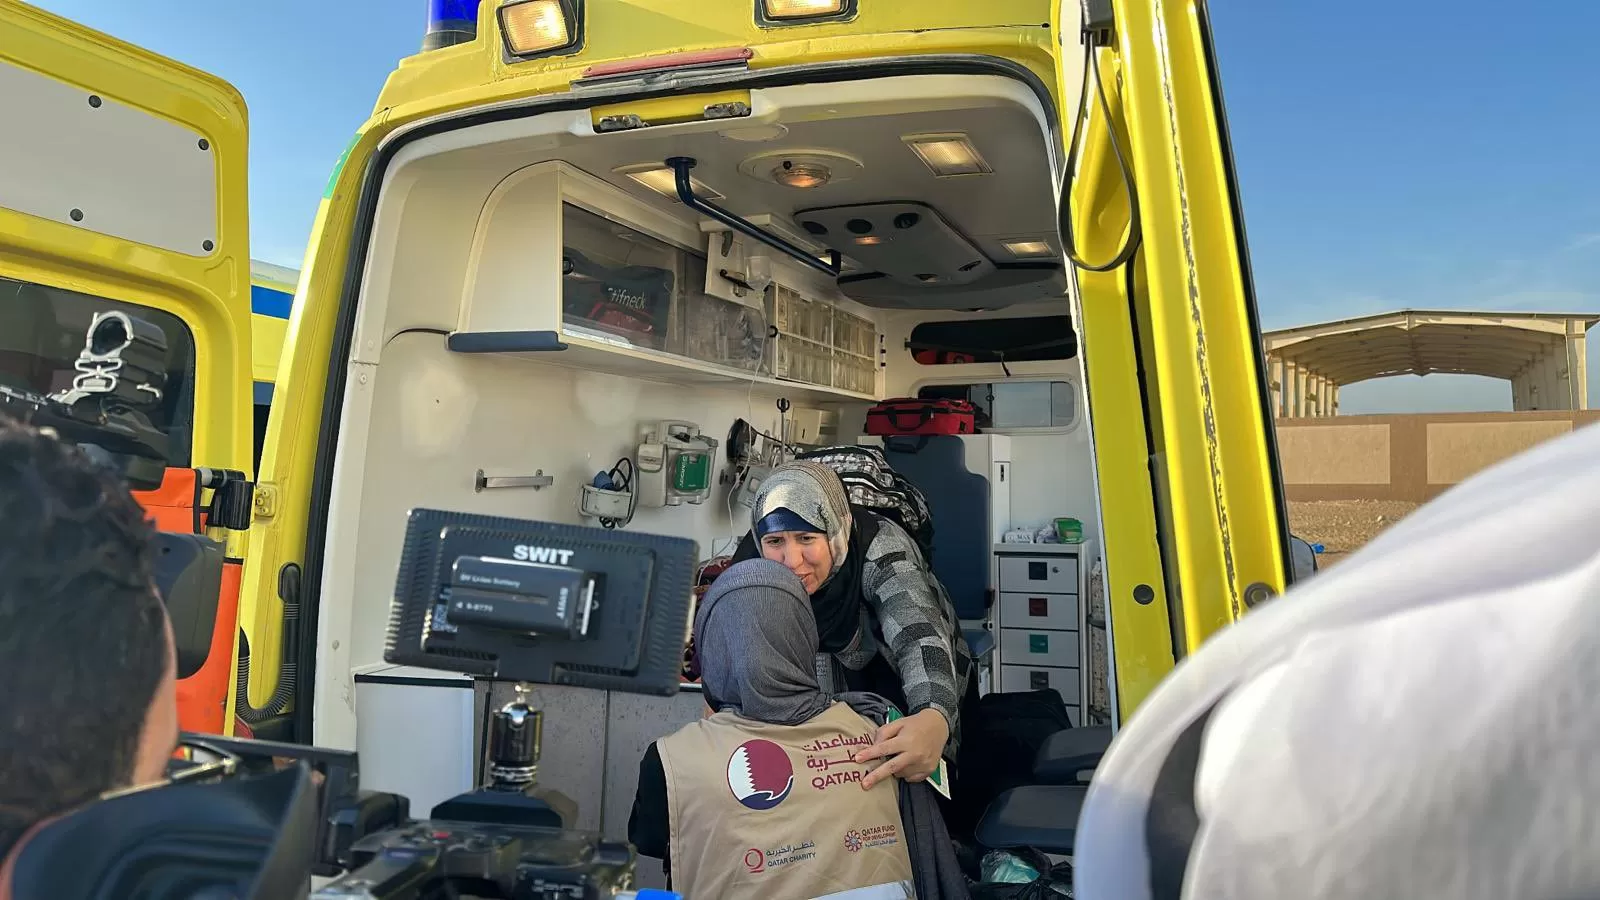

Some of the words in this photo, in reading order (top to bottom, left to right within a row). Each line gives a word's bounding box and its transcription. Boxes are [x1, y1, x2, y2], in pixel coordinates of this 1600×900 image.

[513, 544, 575, 565] SWIT
[801, 733, 873, 751] المساعدات
[811, 770, 862, 790] QATAR
[861, 826, 881, 837] QATAR
[767, 856, 789, 867] QATAR
[789, 851, 817, 863] CHARITY
